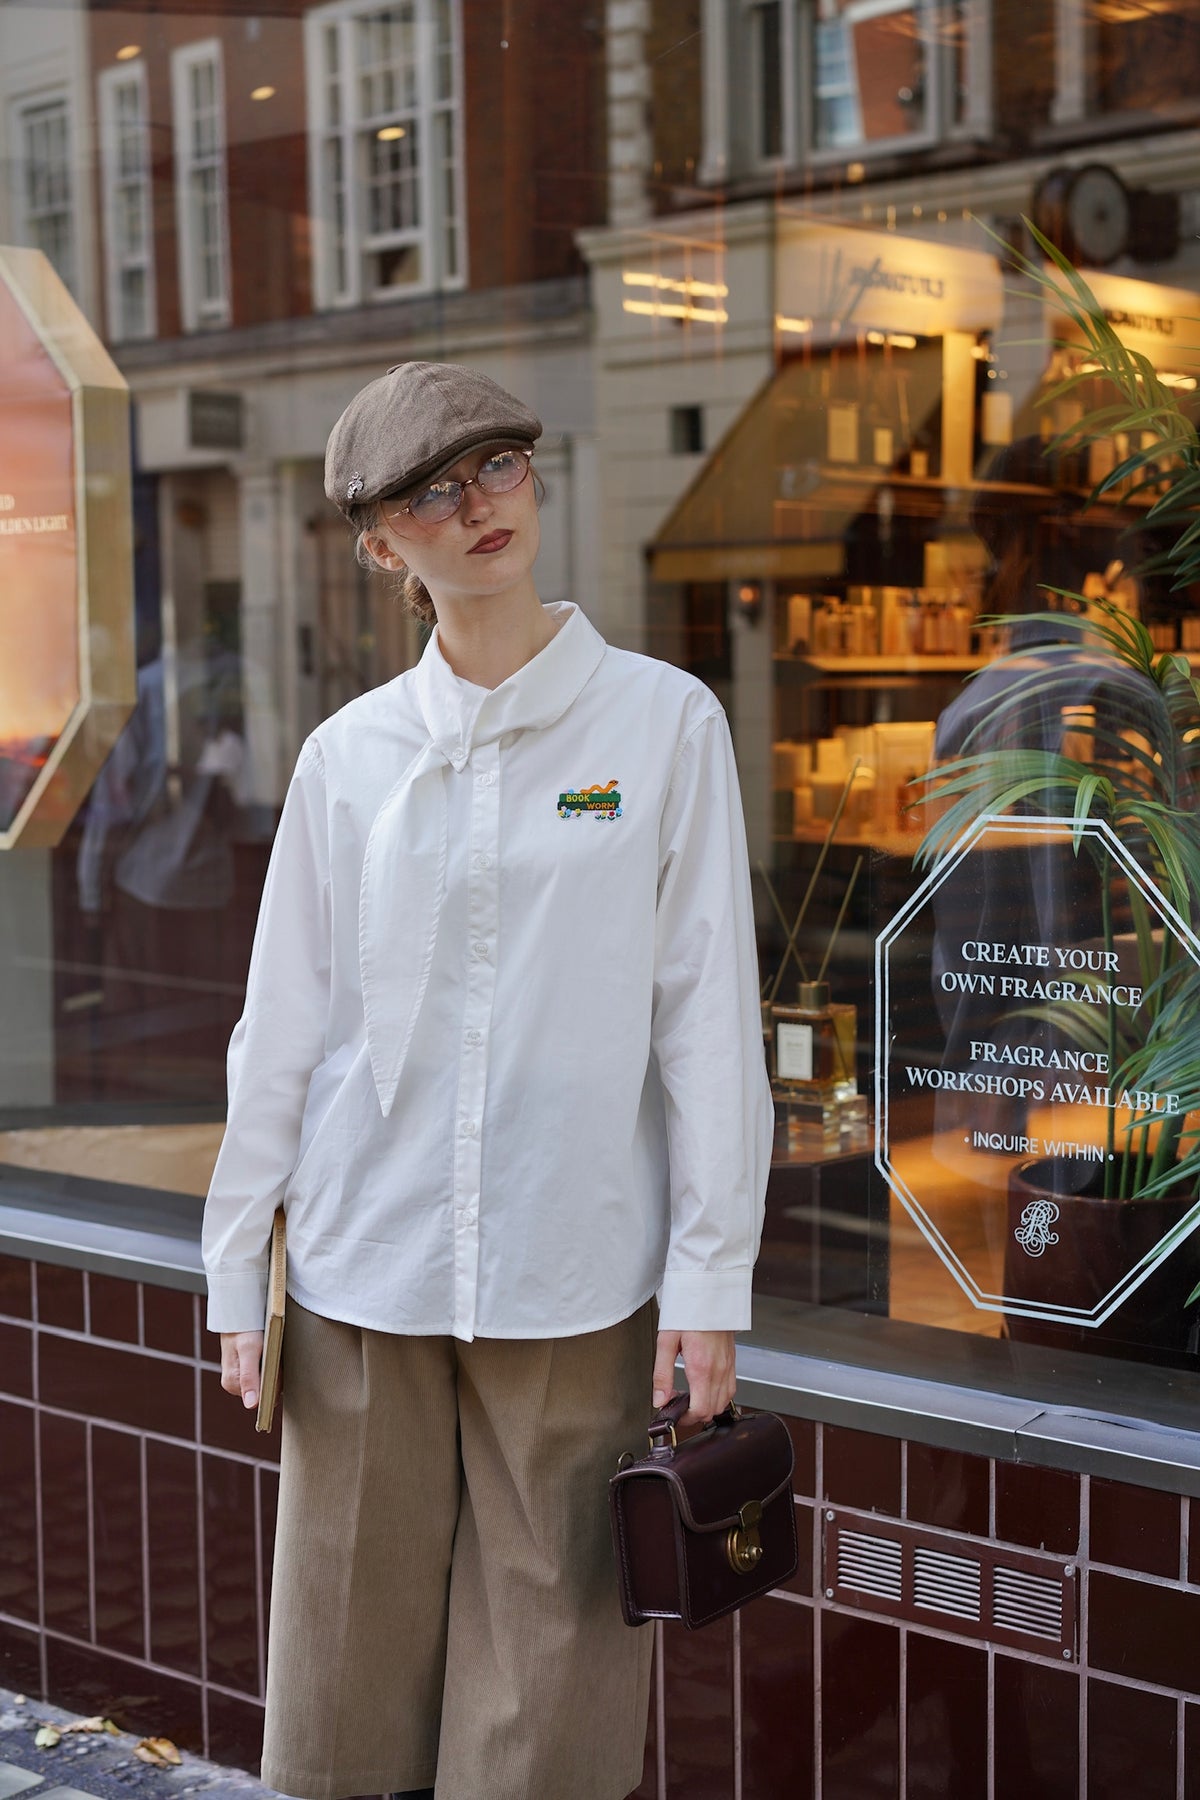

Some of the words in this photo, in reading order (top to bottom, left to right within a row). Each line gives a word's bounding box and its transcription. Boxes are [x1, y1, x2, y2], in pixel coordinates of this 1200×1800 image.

[566, 794, 590, 802] BOOK
[586, 802, 615, 810] WORM
[961, 940, 1049, 967] CREATE
[1054, 948, 1120, 972] YOUR
[940, 972, 995, 996] OWN
[1000, 977, 1142, 1007] FRAGRANCE
[969, 1041, 1109, 1074] FRAGRANCE
[905, 1066, 1044, 1099] WORKSHOPS
[1050, 1082, 1180, 1115] AVAILABLE
[973, 1131, 1039, 1153] INQUIRE
[1043, 1141, 1104, 1163] WITHIN
